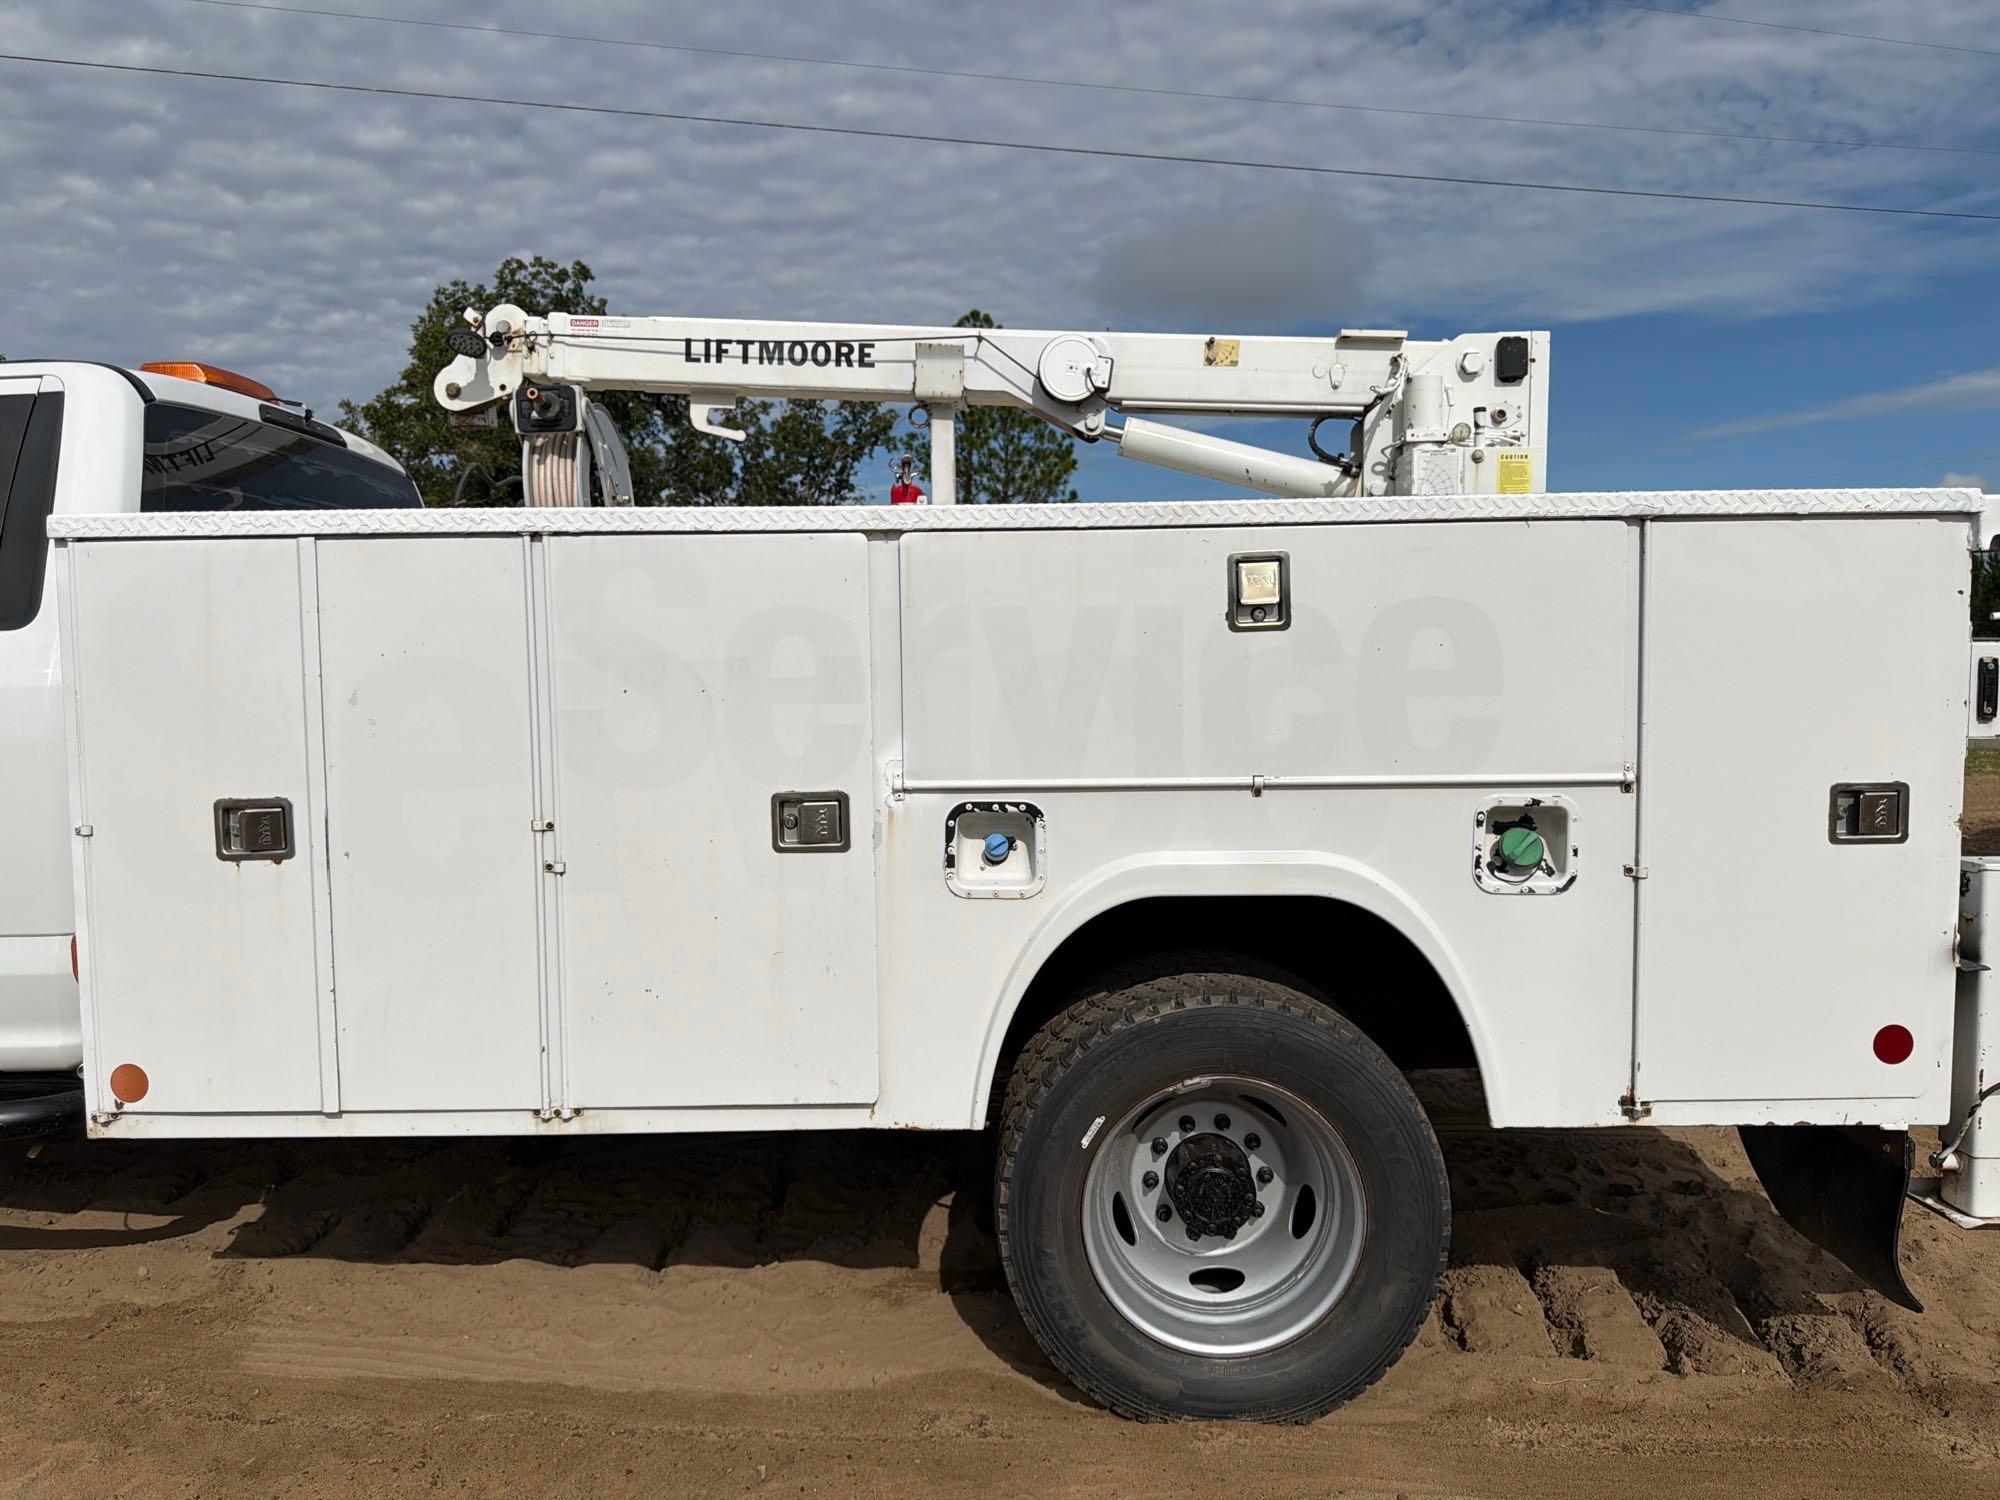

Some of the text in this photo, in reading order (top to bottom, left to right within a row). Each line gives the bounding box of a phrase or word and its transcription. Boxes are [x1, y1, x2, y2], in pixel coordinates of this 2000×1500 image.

[571, 319, 599, 327] DANGER
[685, 338, 876, 368] LIFTMOORE
[556, 536, 1504, 791] Service
